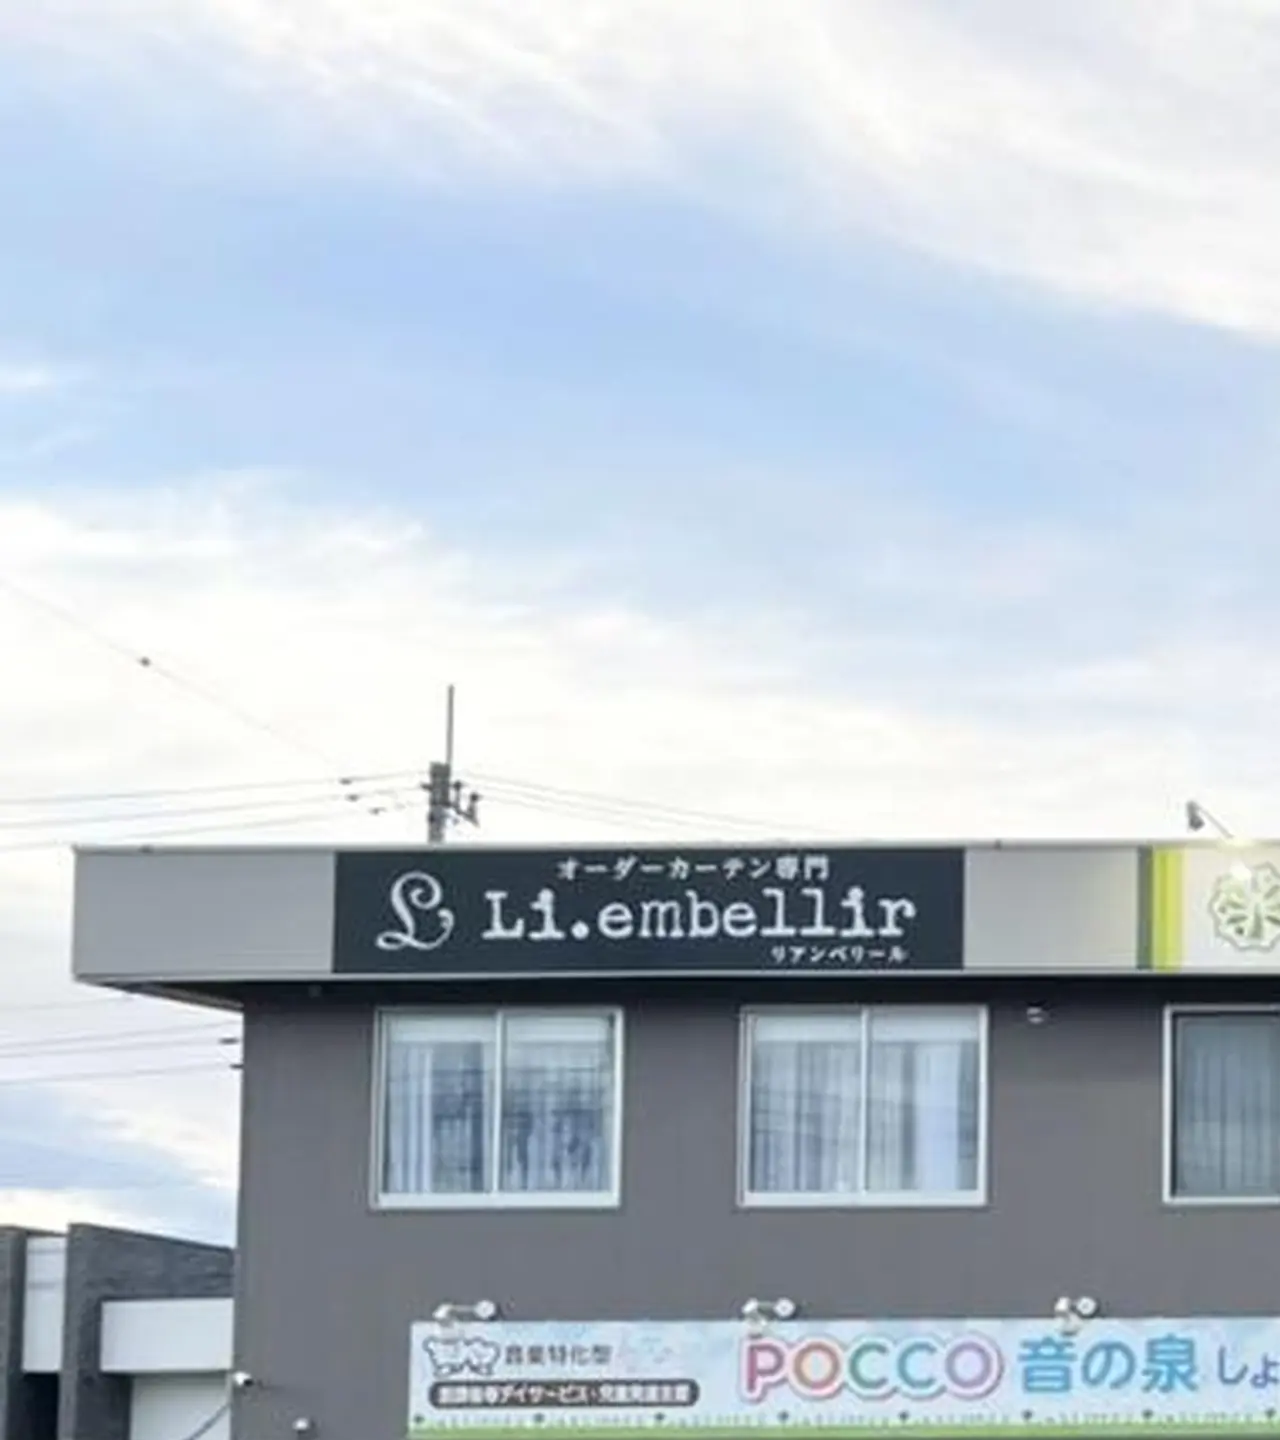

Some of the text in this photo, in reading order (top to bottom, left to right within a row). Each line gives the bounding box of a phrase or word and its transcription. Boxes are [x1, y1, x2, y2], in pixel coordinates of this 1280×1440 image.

[556, 856, 831, 881] オーダーカーテン専門
[480, 885, 917, 941] Li.embellir
[742, 1340, 998, 1395] POCCO
[1017, 1333, 1198, 1395] 音の泉
